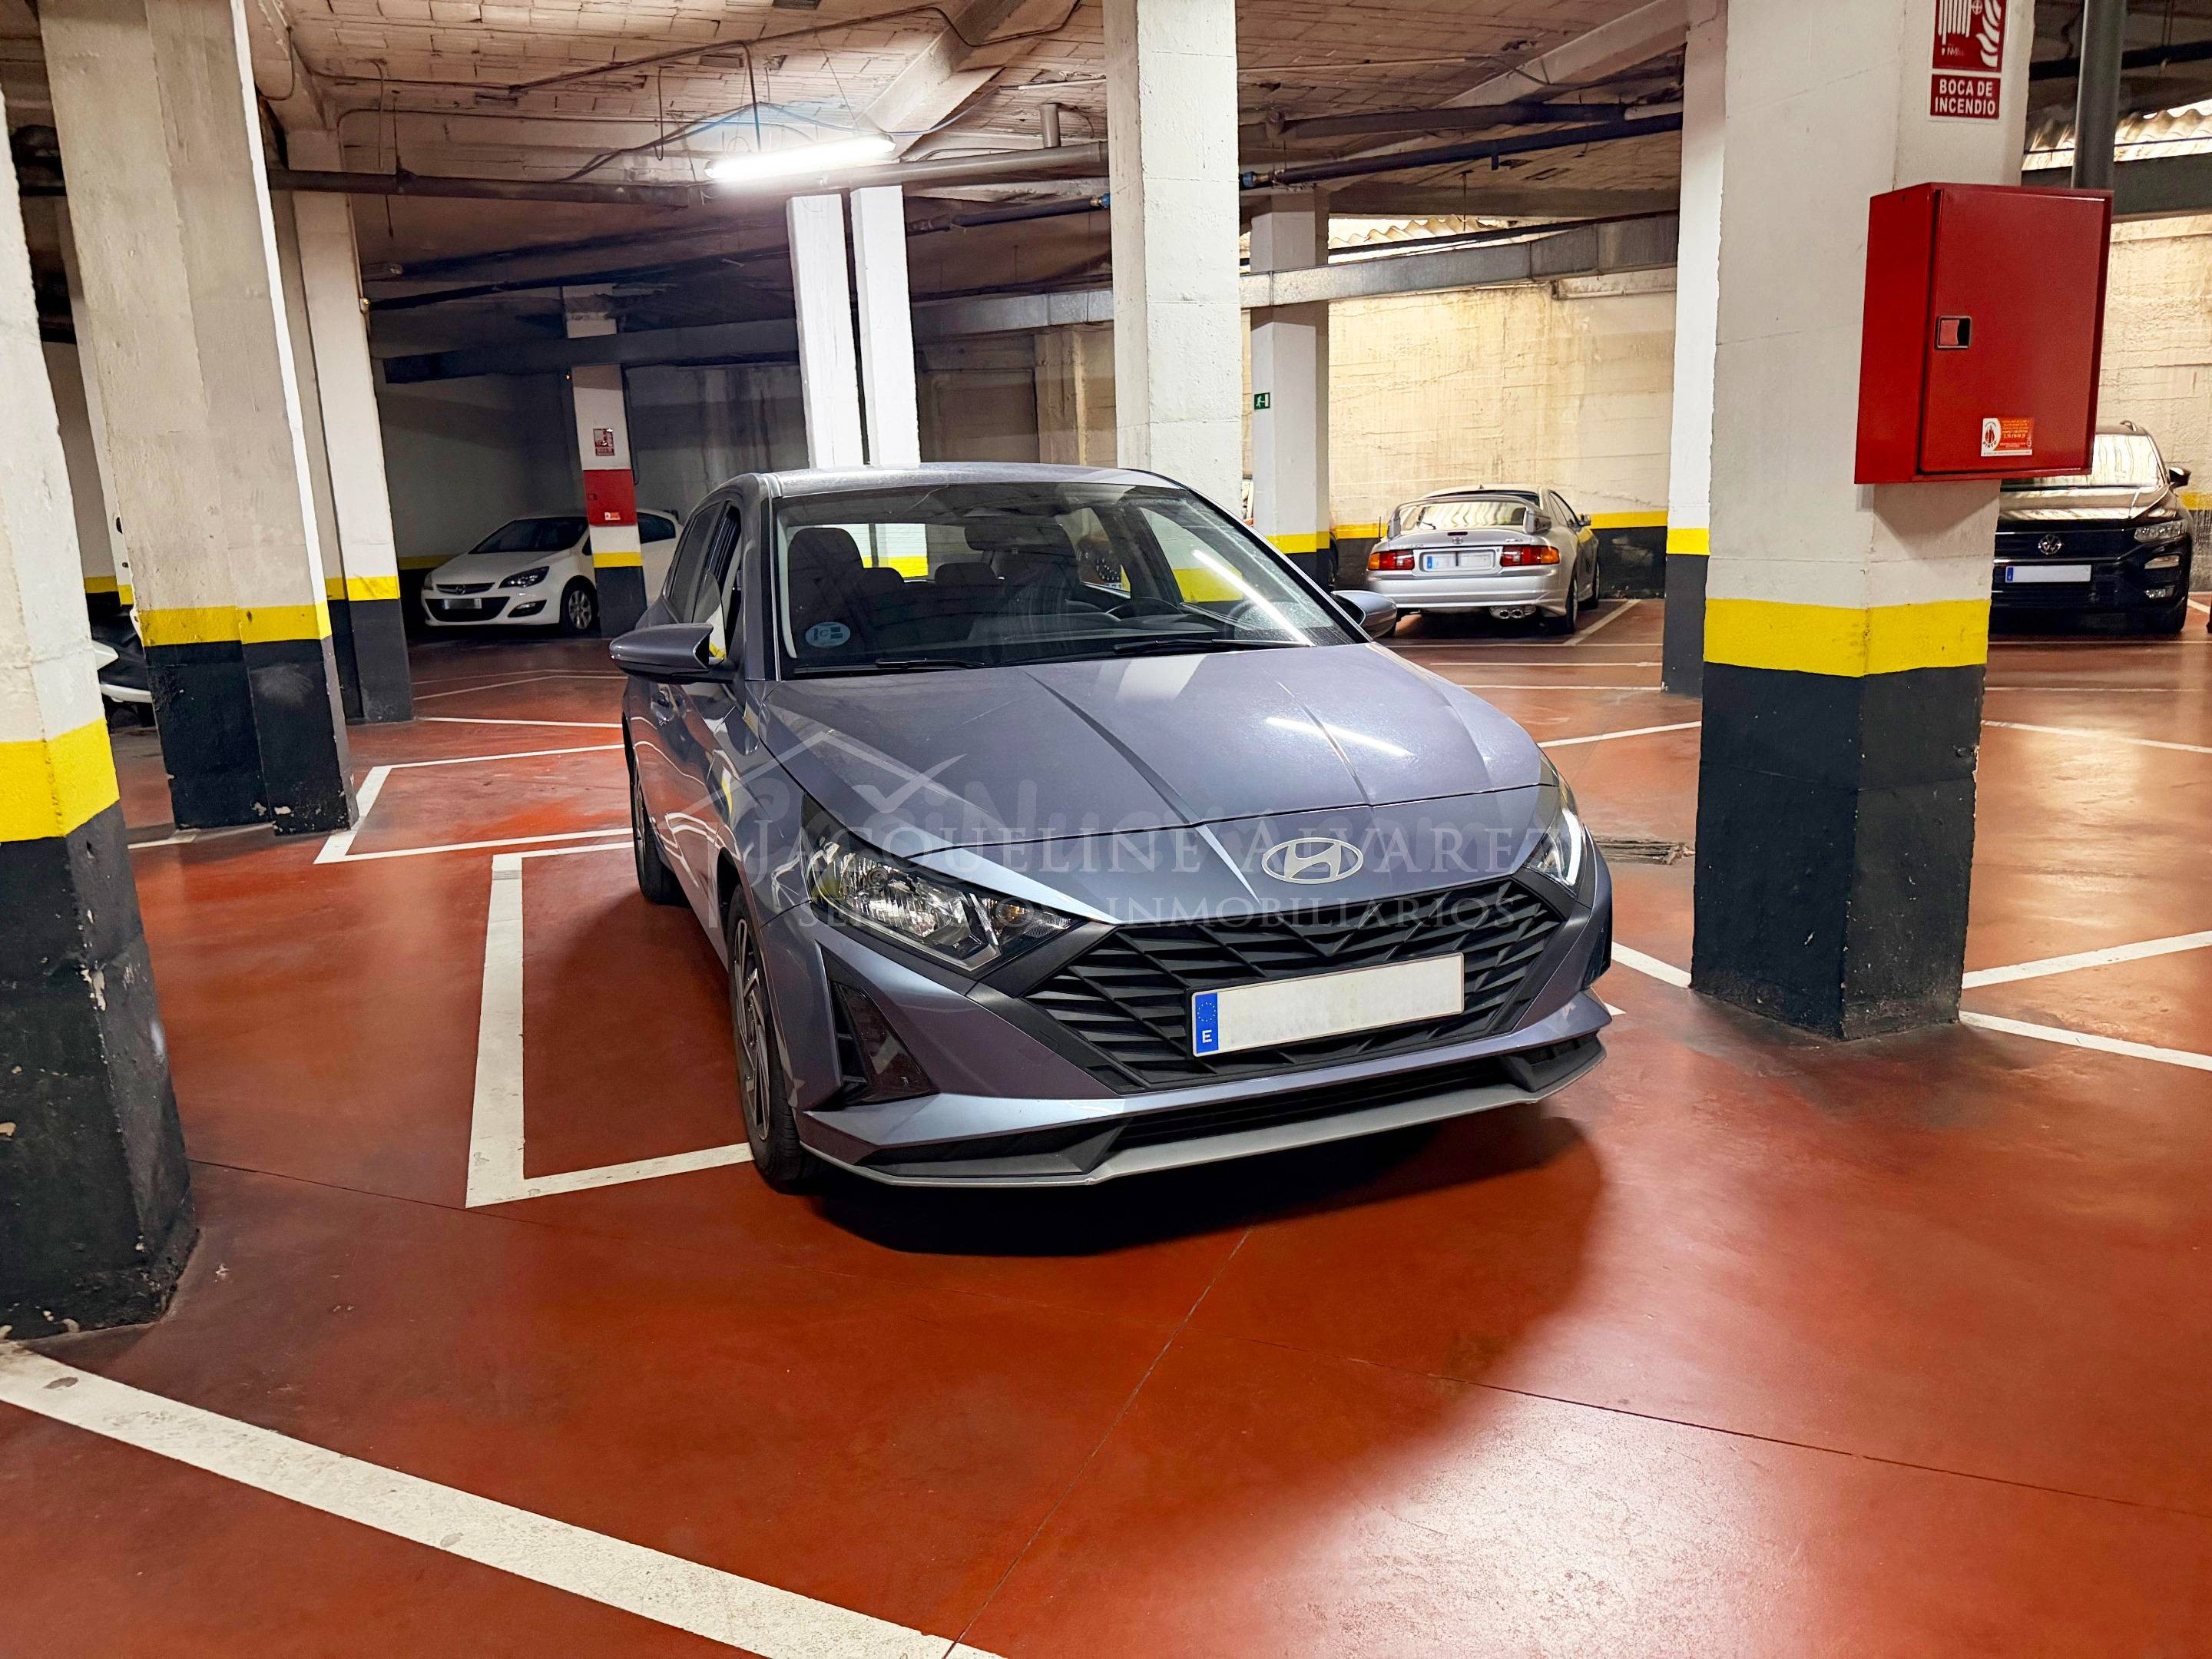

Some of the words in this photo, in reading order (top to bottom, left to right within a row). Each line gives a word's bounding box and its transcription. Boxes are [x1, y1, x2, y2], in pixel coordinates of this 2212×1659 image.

[1939, 78, 1974, 96] BOCA
[1977, 81, 1993, 98] DE
[1935, 96, 1995, 115] INCENDIO
[1202, 1029, 1213, 1043] E
